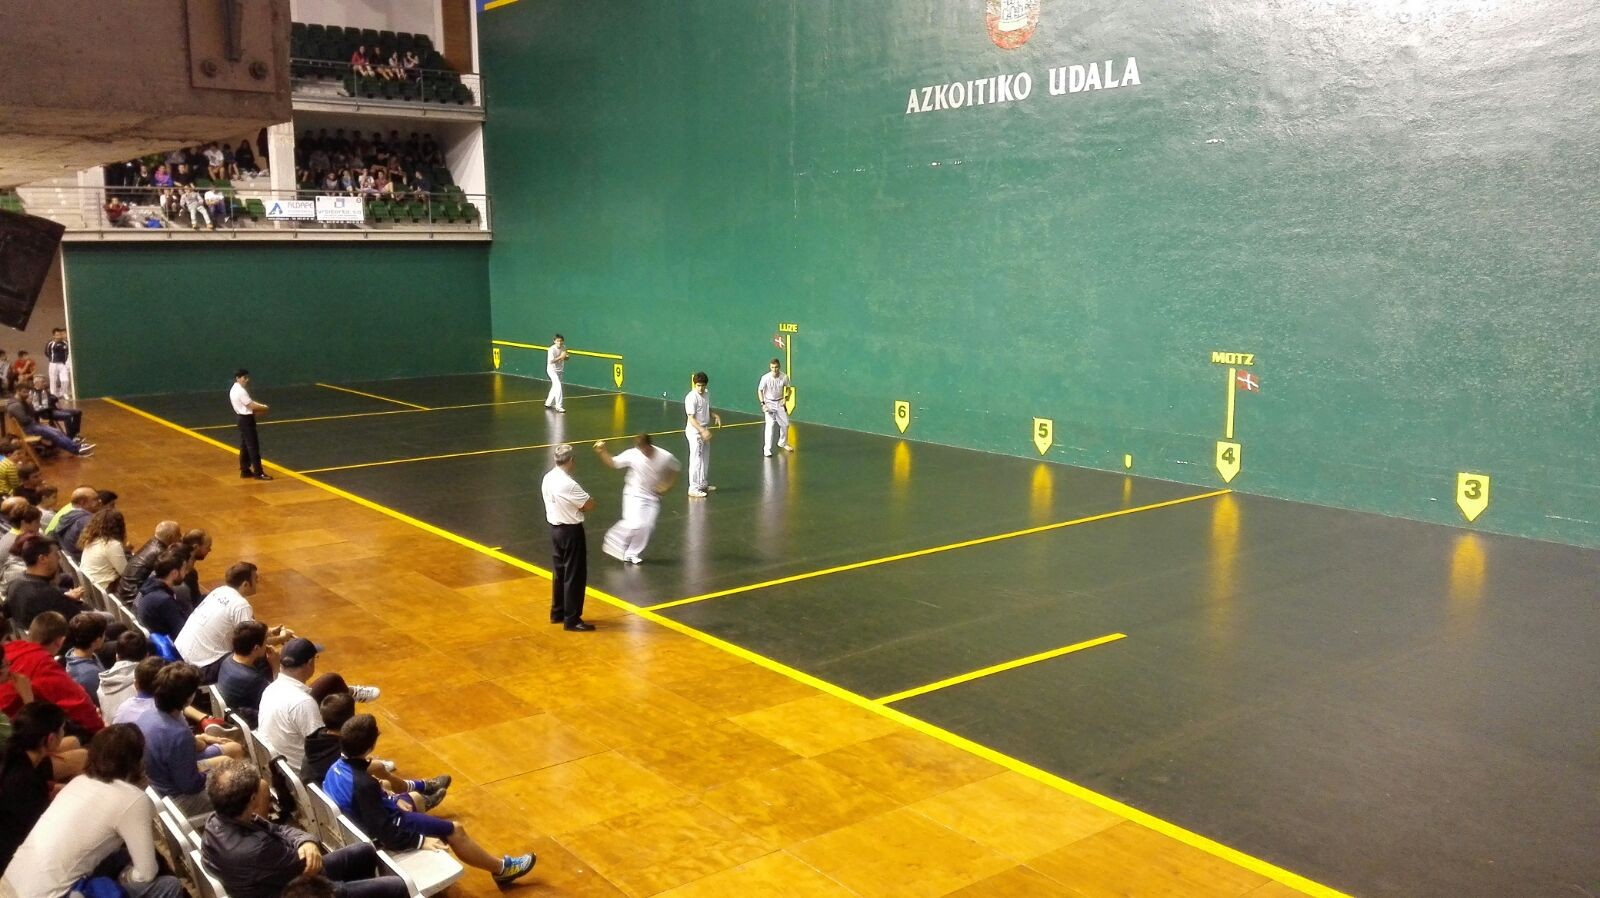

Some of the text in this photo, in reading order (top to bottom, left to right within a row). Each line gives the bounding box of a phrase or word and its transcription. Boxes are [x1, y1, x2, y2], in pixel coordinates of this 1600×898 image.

[906, 56, 1142, 114] AZKOITIKO UDALA
[779, 323, 798, 333] LUZE
[1211, 351, 1255, 365] MOTZ
[615, 366, 621, 378] 9
[897, 405, 906, 419] 6
[1038, 422, 1049, 439] 5
[1221, 447, 1236, 465] 4
[1464, 479, 1482, 500] 3
